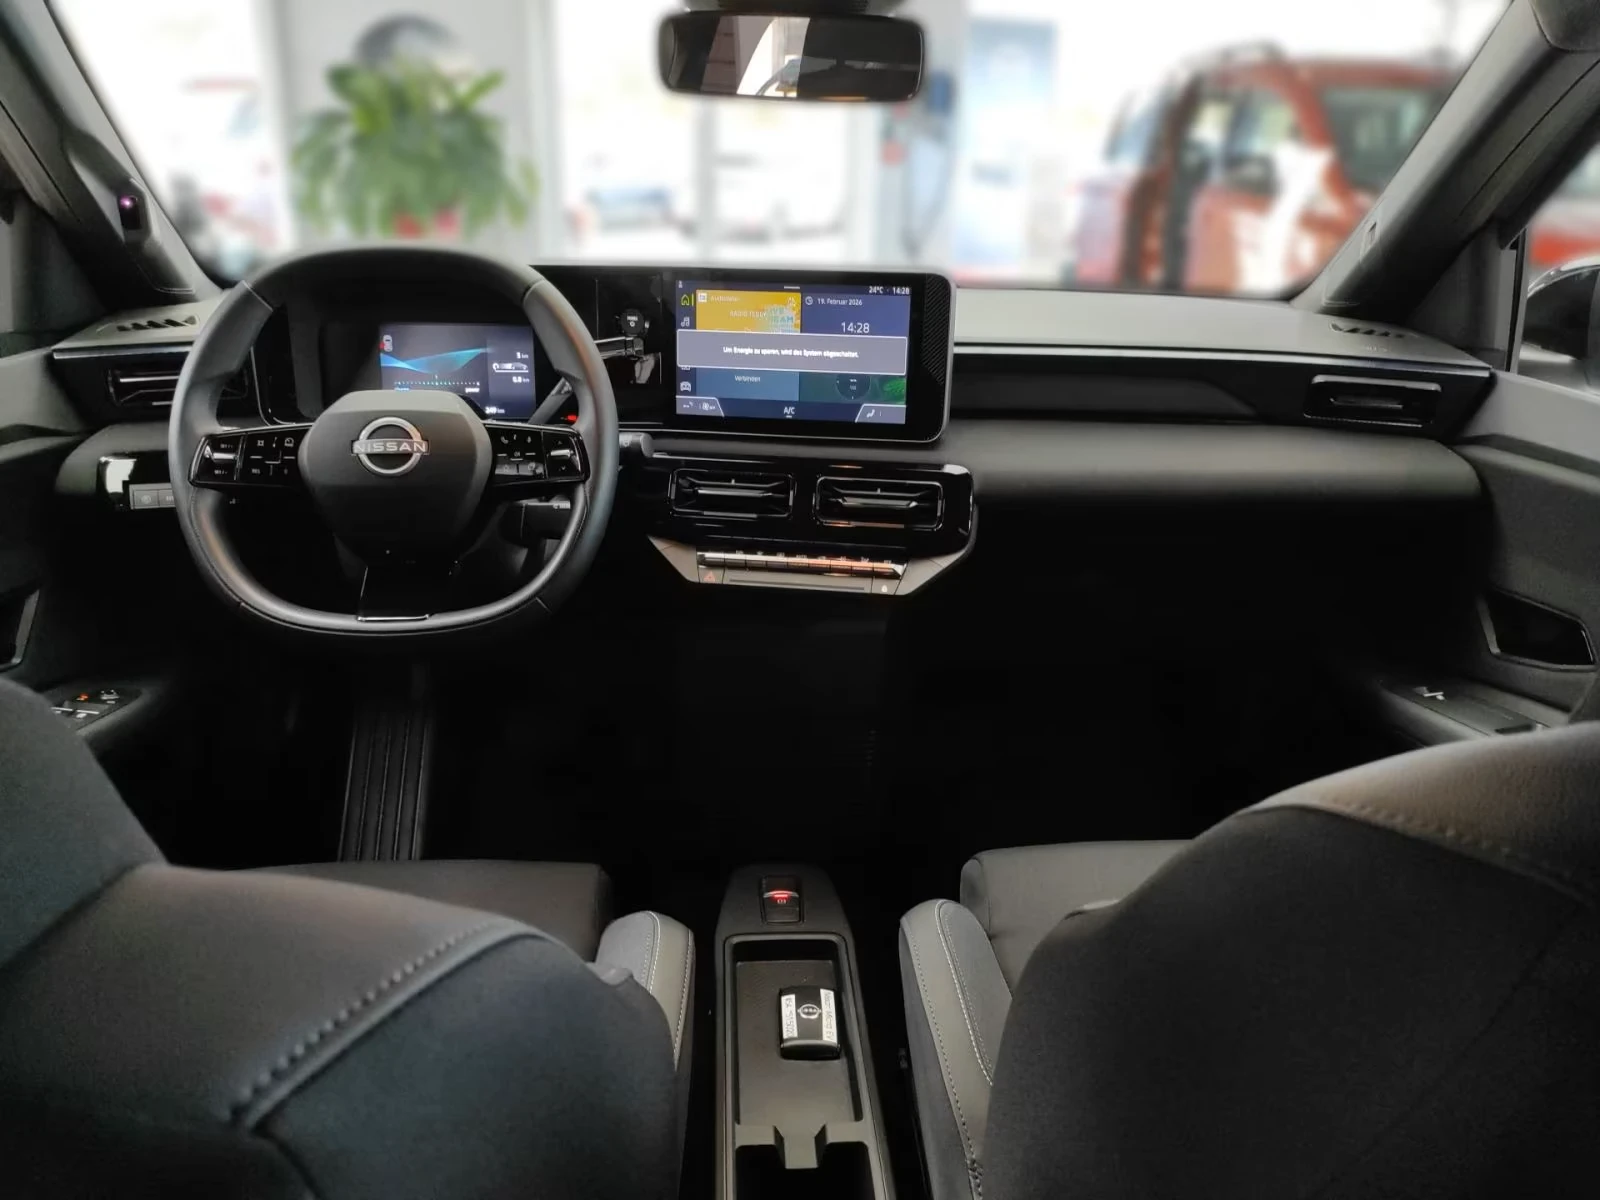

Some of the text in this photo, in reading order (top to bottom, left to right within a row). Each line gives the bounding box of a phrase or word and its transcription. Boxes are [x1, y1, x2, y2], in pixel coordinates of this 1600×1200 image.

[892, 287, 910, 295] 14:28
[841, 321, 870, 333] 14:28
[783, 406, 795, 415] A/C
[354, 442, 426, 453] NISSAN
